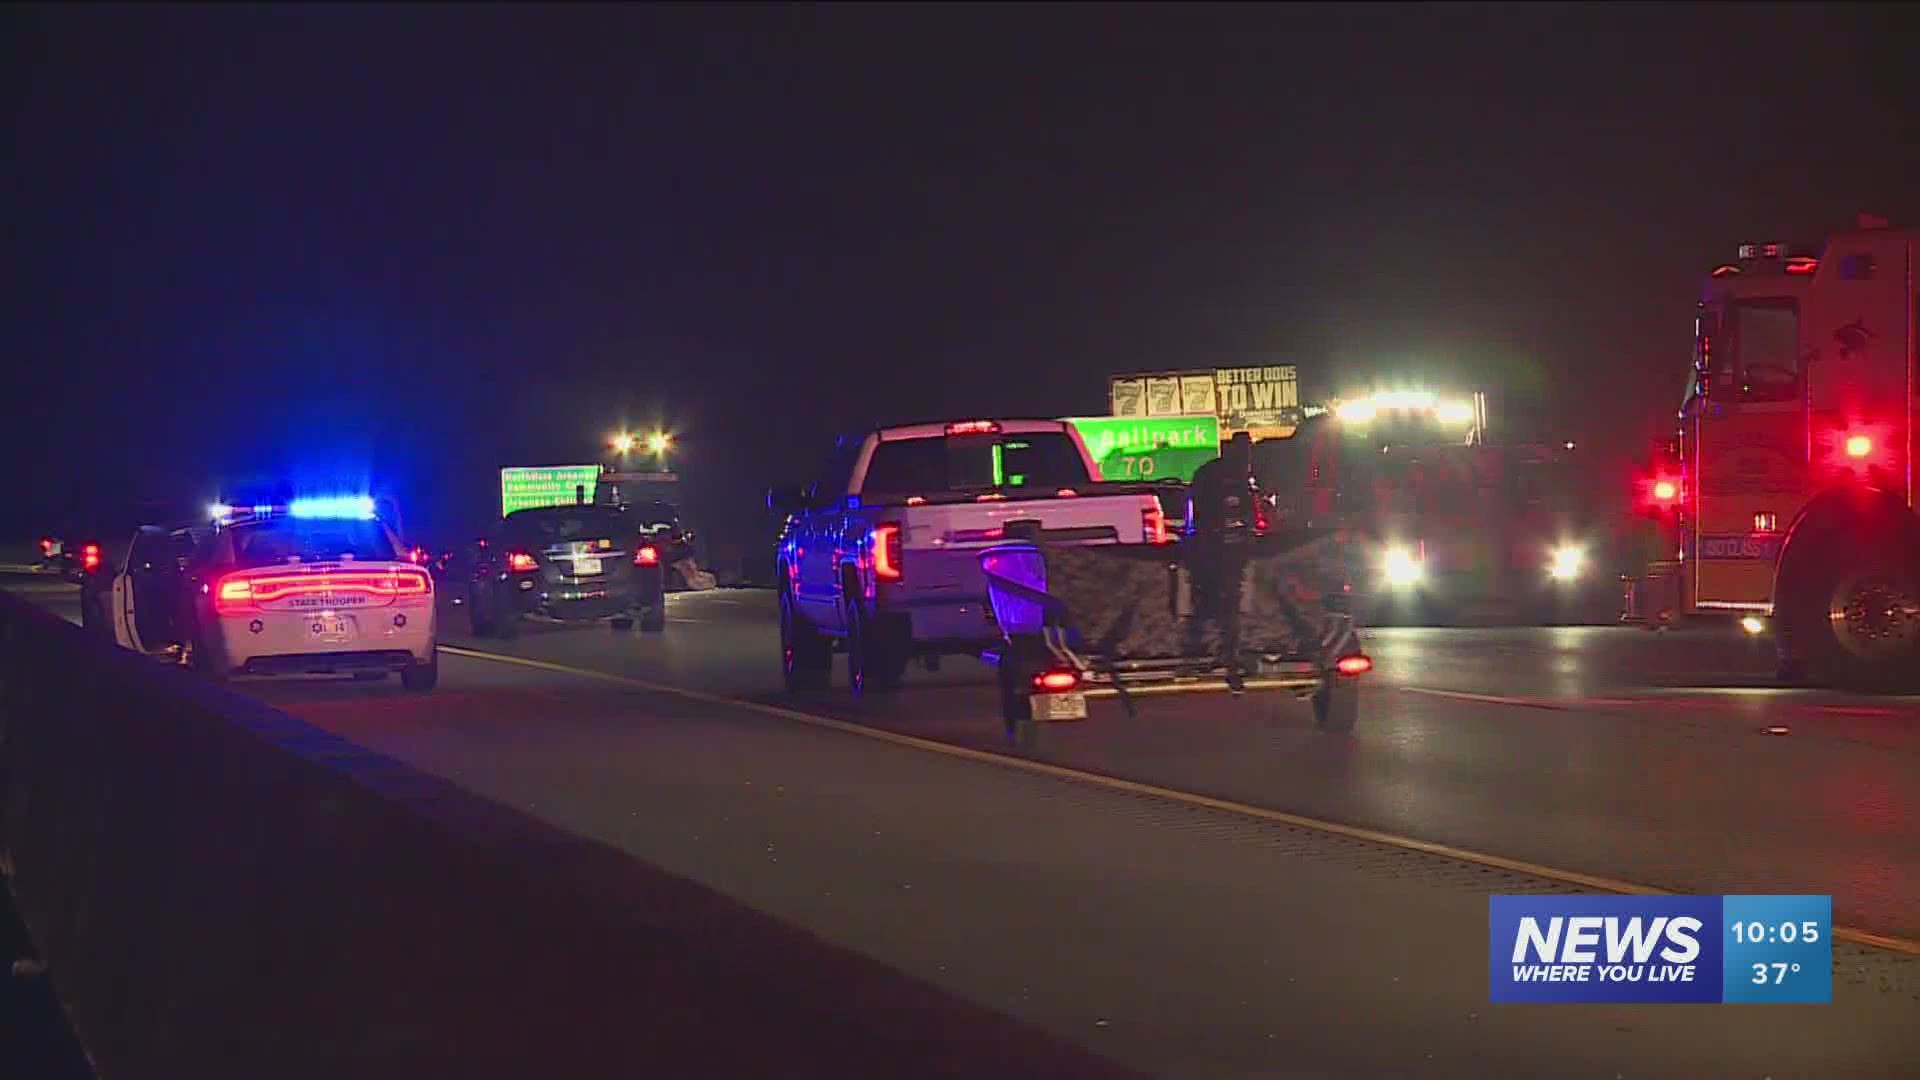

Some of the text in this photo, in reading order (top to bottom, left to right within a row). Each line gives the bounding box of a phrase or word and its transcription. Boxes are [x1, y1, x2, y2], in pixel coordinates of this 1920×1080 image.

[1217, 366, 1297, 384] BETTER ODDS
[1217, 381, 1298, 410] TO WIN
[1100, 425, 1208, 450] Ballpark
[1121, 456, 1155, 476] 70
[288, 597, 365, 607] STATE TROOPER
